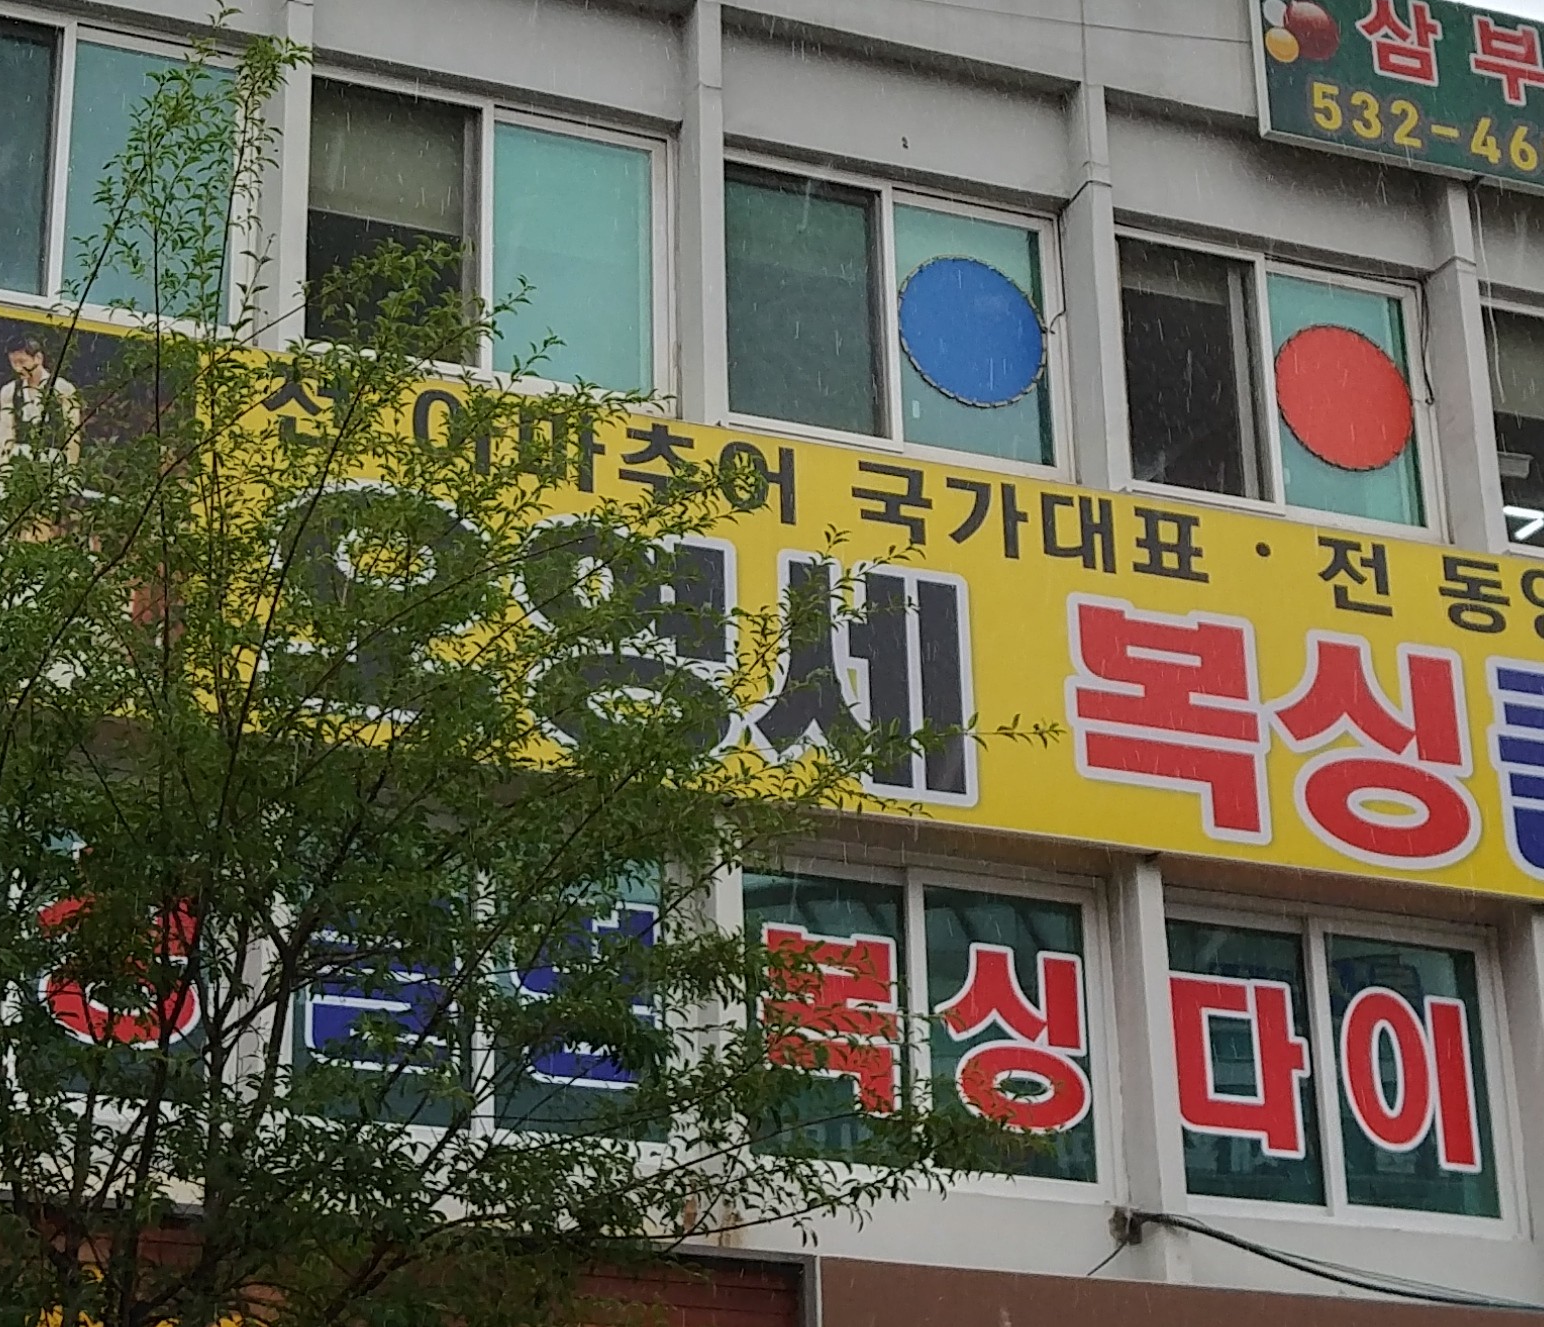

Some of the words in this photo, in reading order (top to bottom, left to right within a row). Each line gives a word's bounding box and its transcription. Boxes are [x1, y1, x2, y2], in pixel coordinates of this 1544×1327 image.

[412, 389, 798, 526] 아마추어
[851, 459, 1211, 584] 국가대표
[1318, 535, 1395, 617] 전
